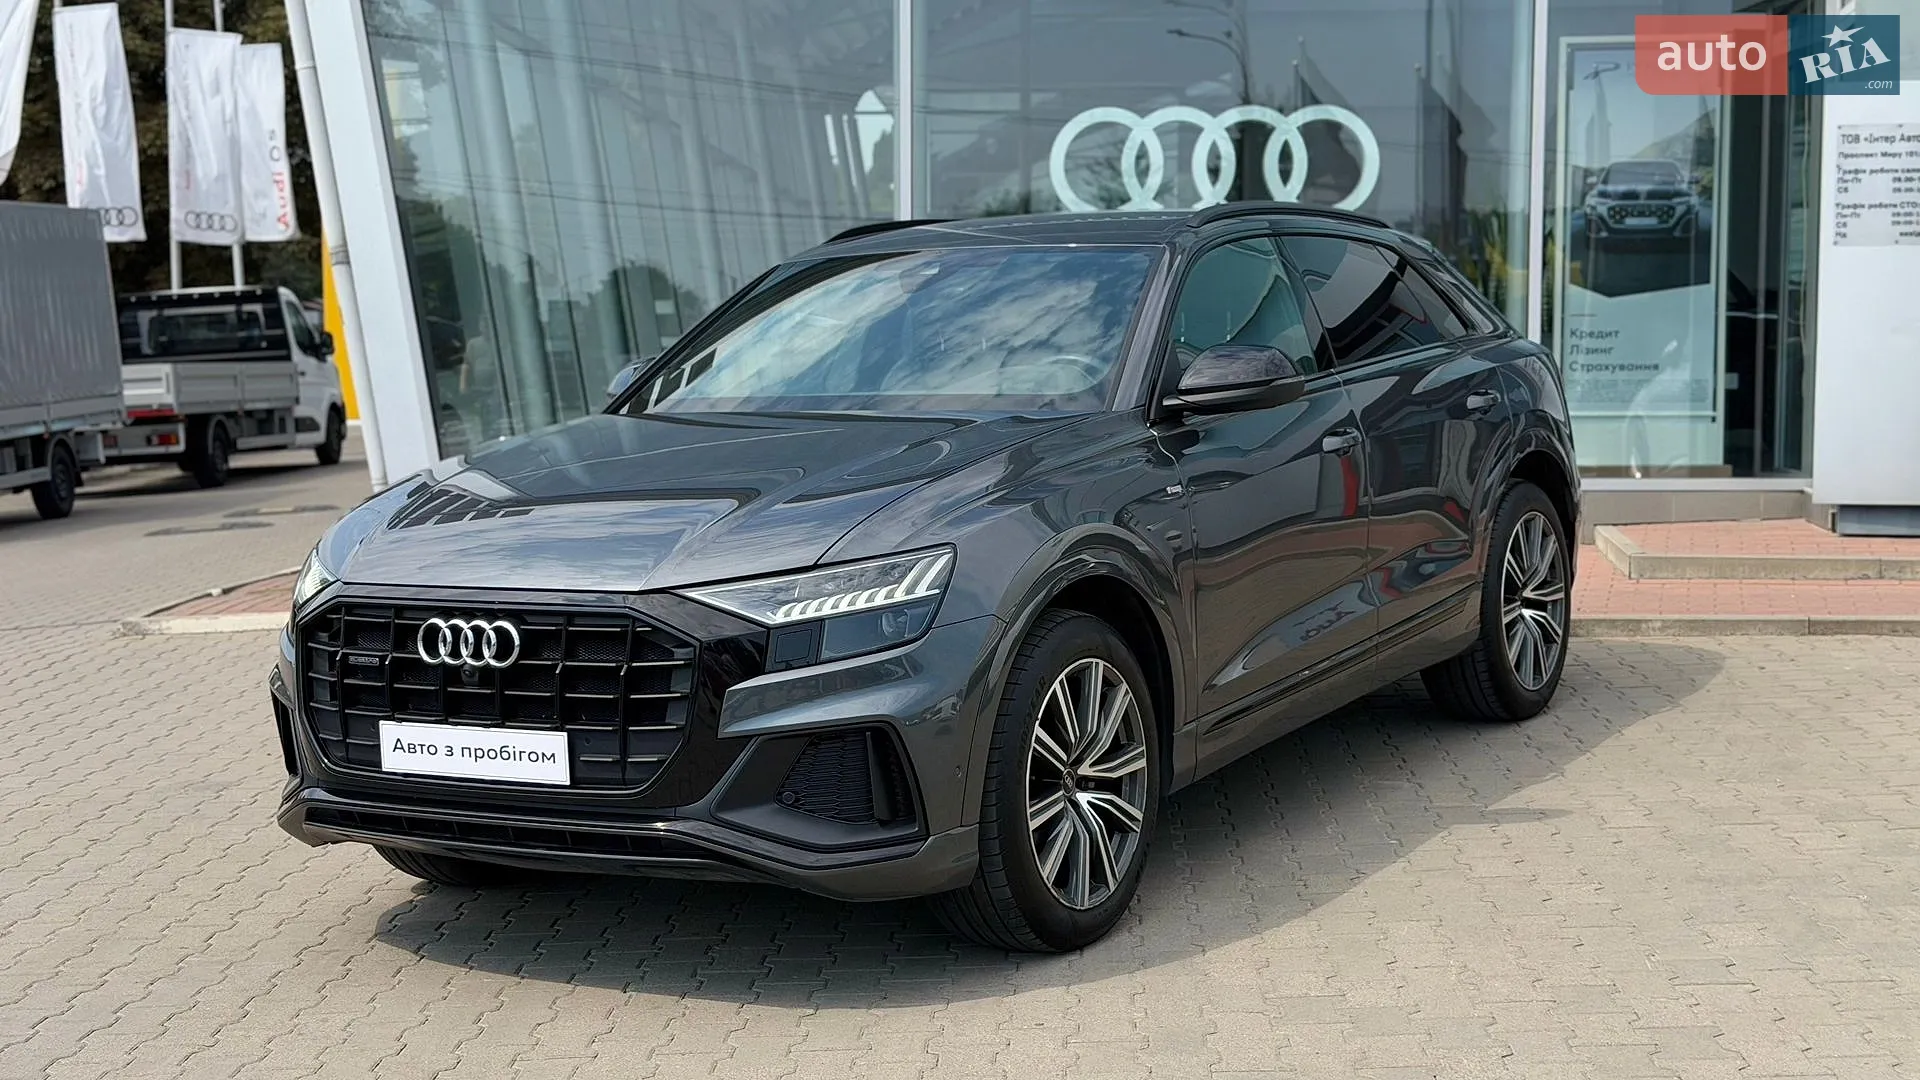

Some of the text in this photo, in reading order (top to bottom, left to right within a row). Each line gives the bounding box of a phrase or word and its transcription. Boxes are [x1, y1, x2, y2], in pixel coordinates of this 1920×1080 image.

[1841, 134, 1860, 144] ТОВ
[271, 171, 290, 229] Audi
[1569, 328, 1620, 340] Кредит
[1569, 361, 1660, 373] Страхування
[392, 737, 557, 764] Авто з пробігом
